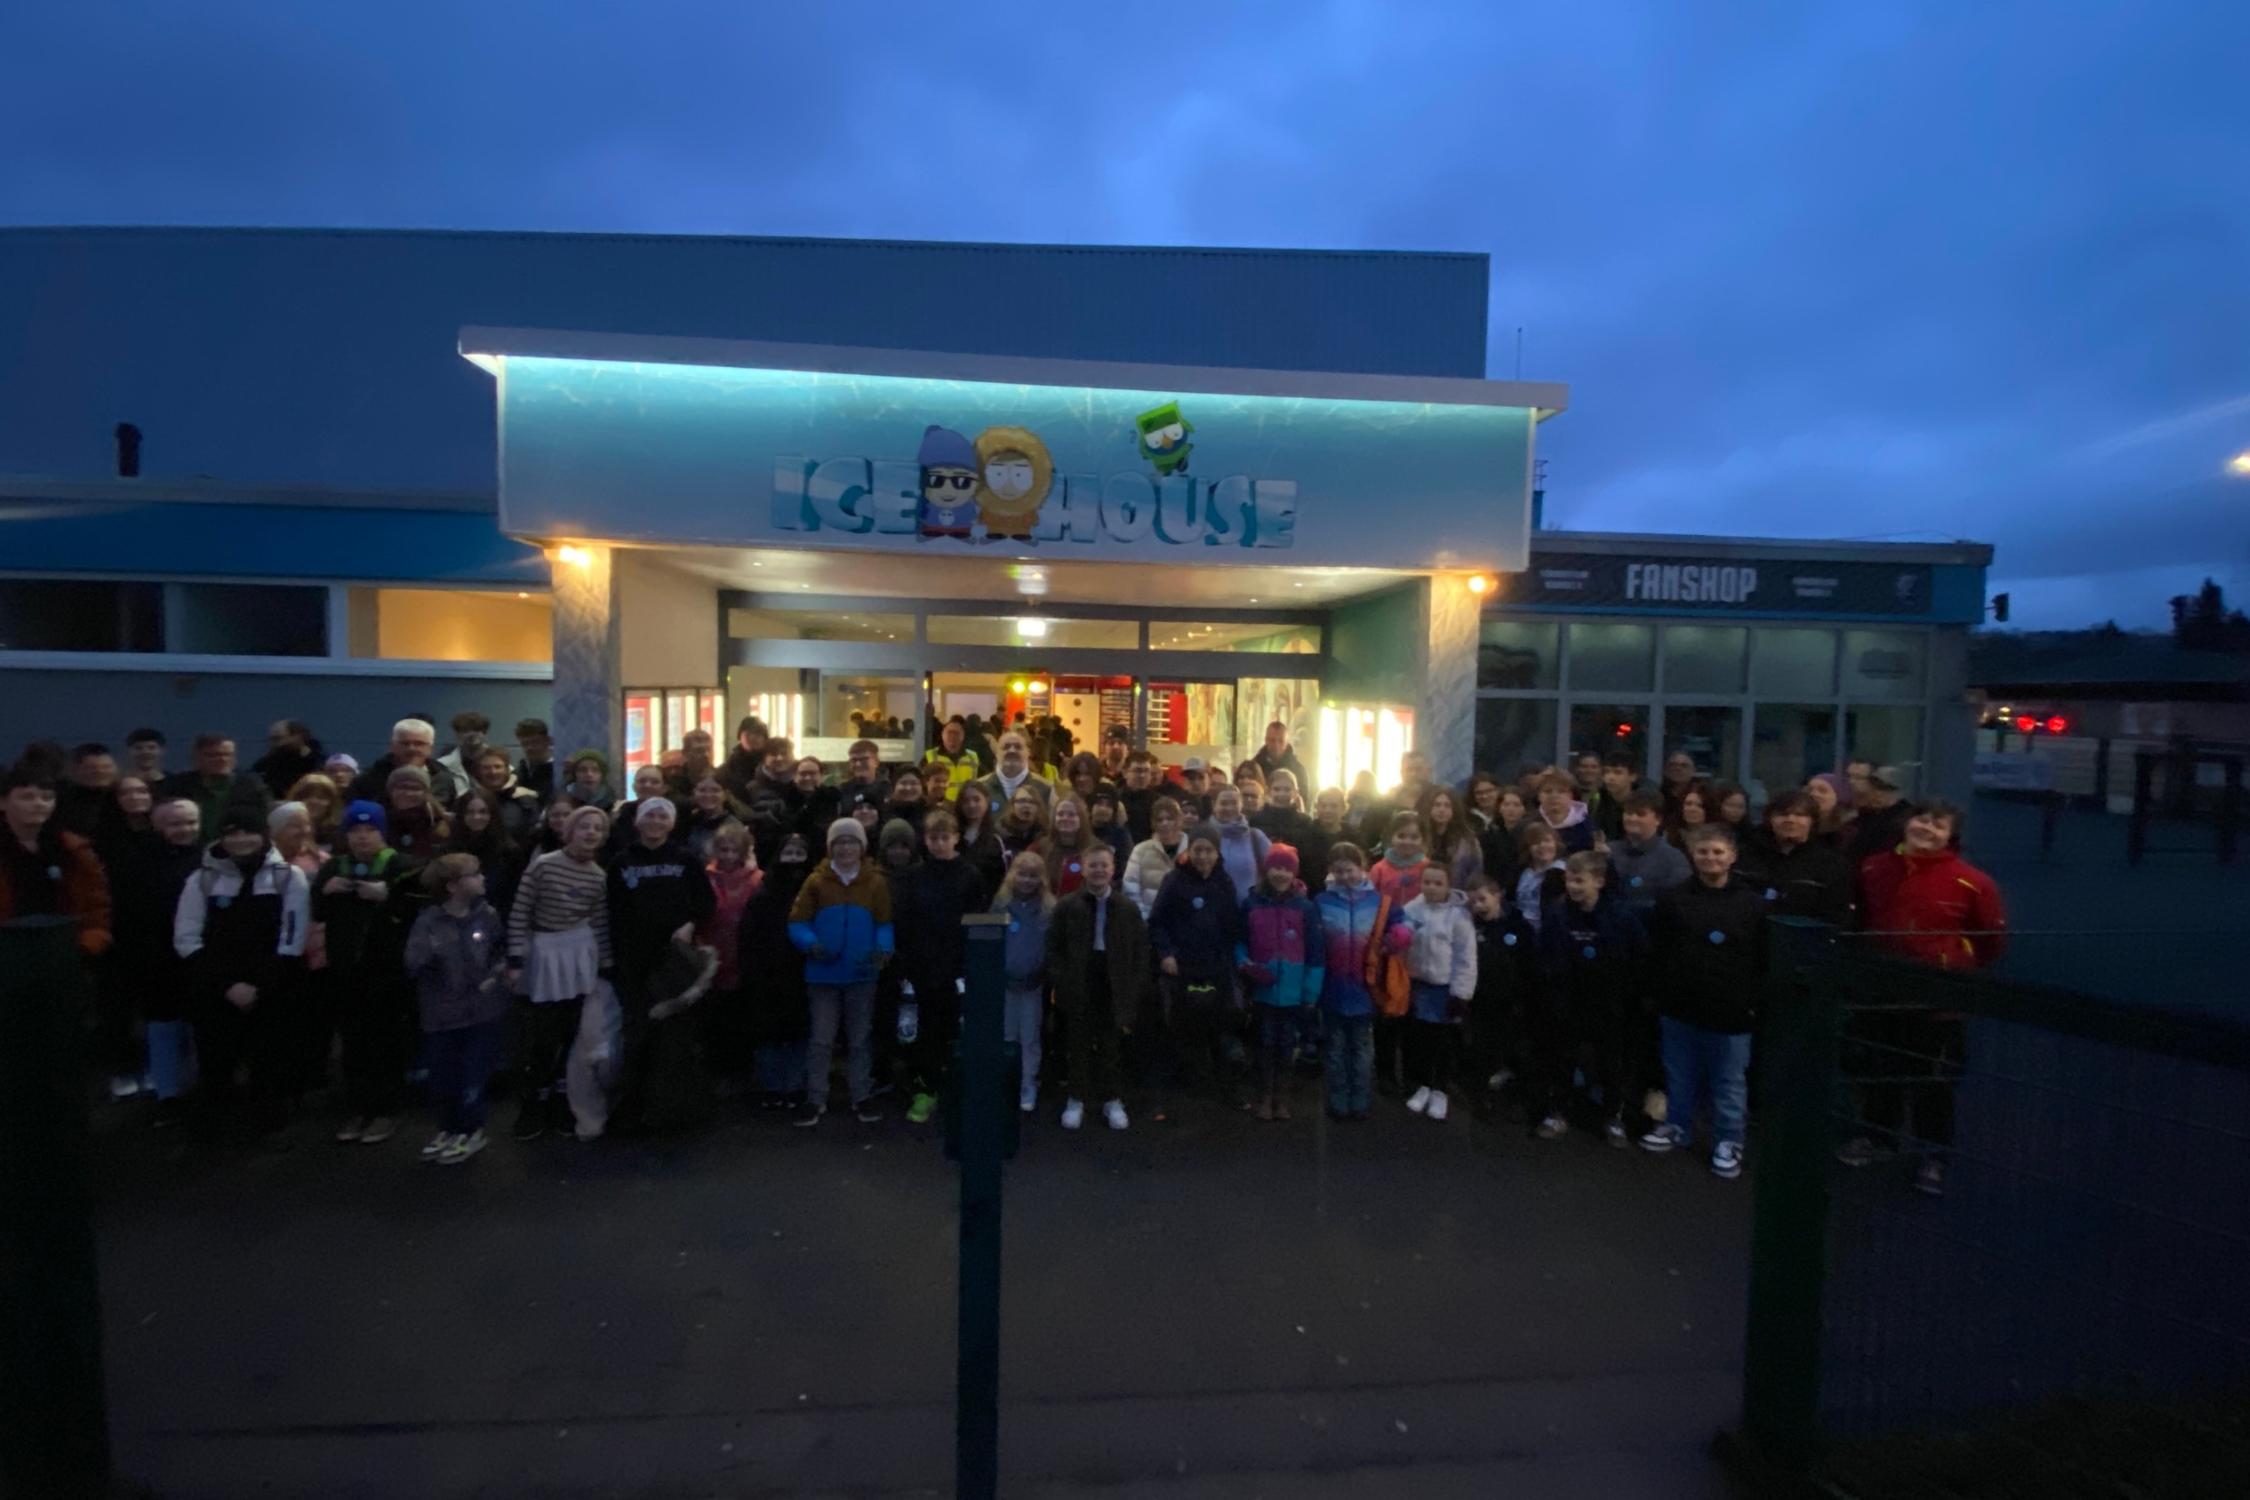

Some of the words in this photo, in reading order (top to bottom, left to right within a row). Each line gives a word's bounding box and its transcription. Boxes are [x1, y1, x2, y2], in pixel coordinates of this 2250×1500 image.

[773, 456, 924, 534] ICE
[1037, 469, 1298, 548] HOUSE
[1626, 563, 1757, 602] FANSHOP
